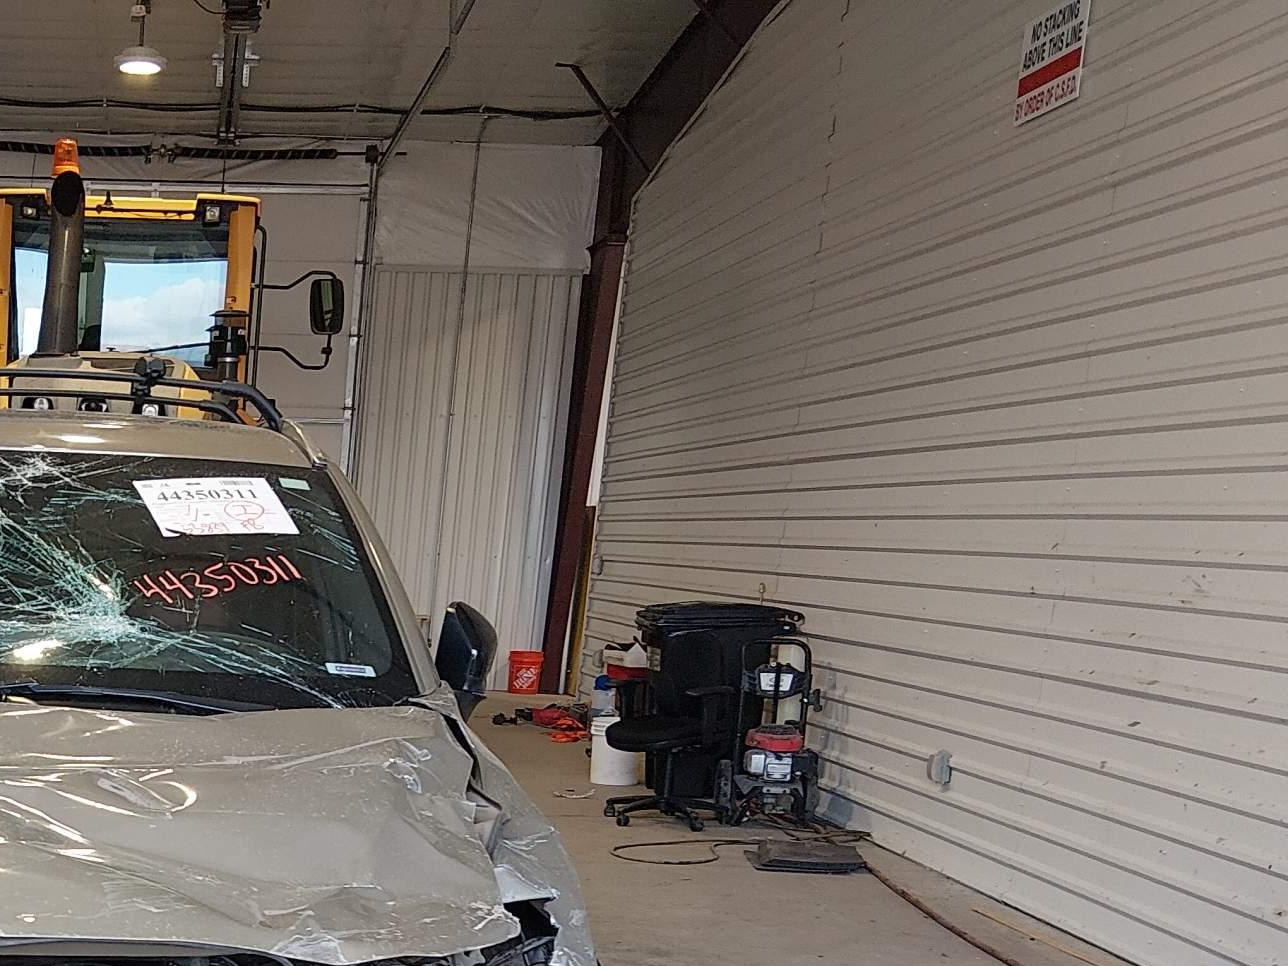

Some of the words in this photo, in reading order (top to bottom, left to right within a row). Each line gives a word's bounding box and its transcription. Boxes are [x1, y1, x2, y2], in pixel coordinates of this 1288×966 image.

[1031, 20, 1043, 43] NO
[1043, 0, 1081, 36] STACKING
[1022, 41, 1047, 72] ABOVE
[1048, 31, 1065, 57] THIS
[1065, 20, 1084, 49] LINE
[1015, 102, 1024, 121] BY
[1024, 90, 1045, 117] ORDER
[1045, 85, 1055, 107] OF
[157, 489, 258, 501] 44350311
[133, 554, 303, 604] 44350311
